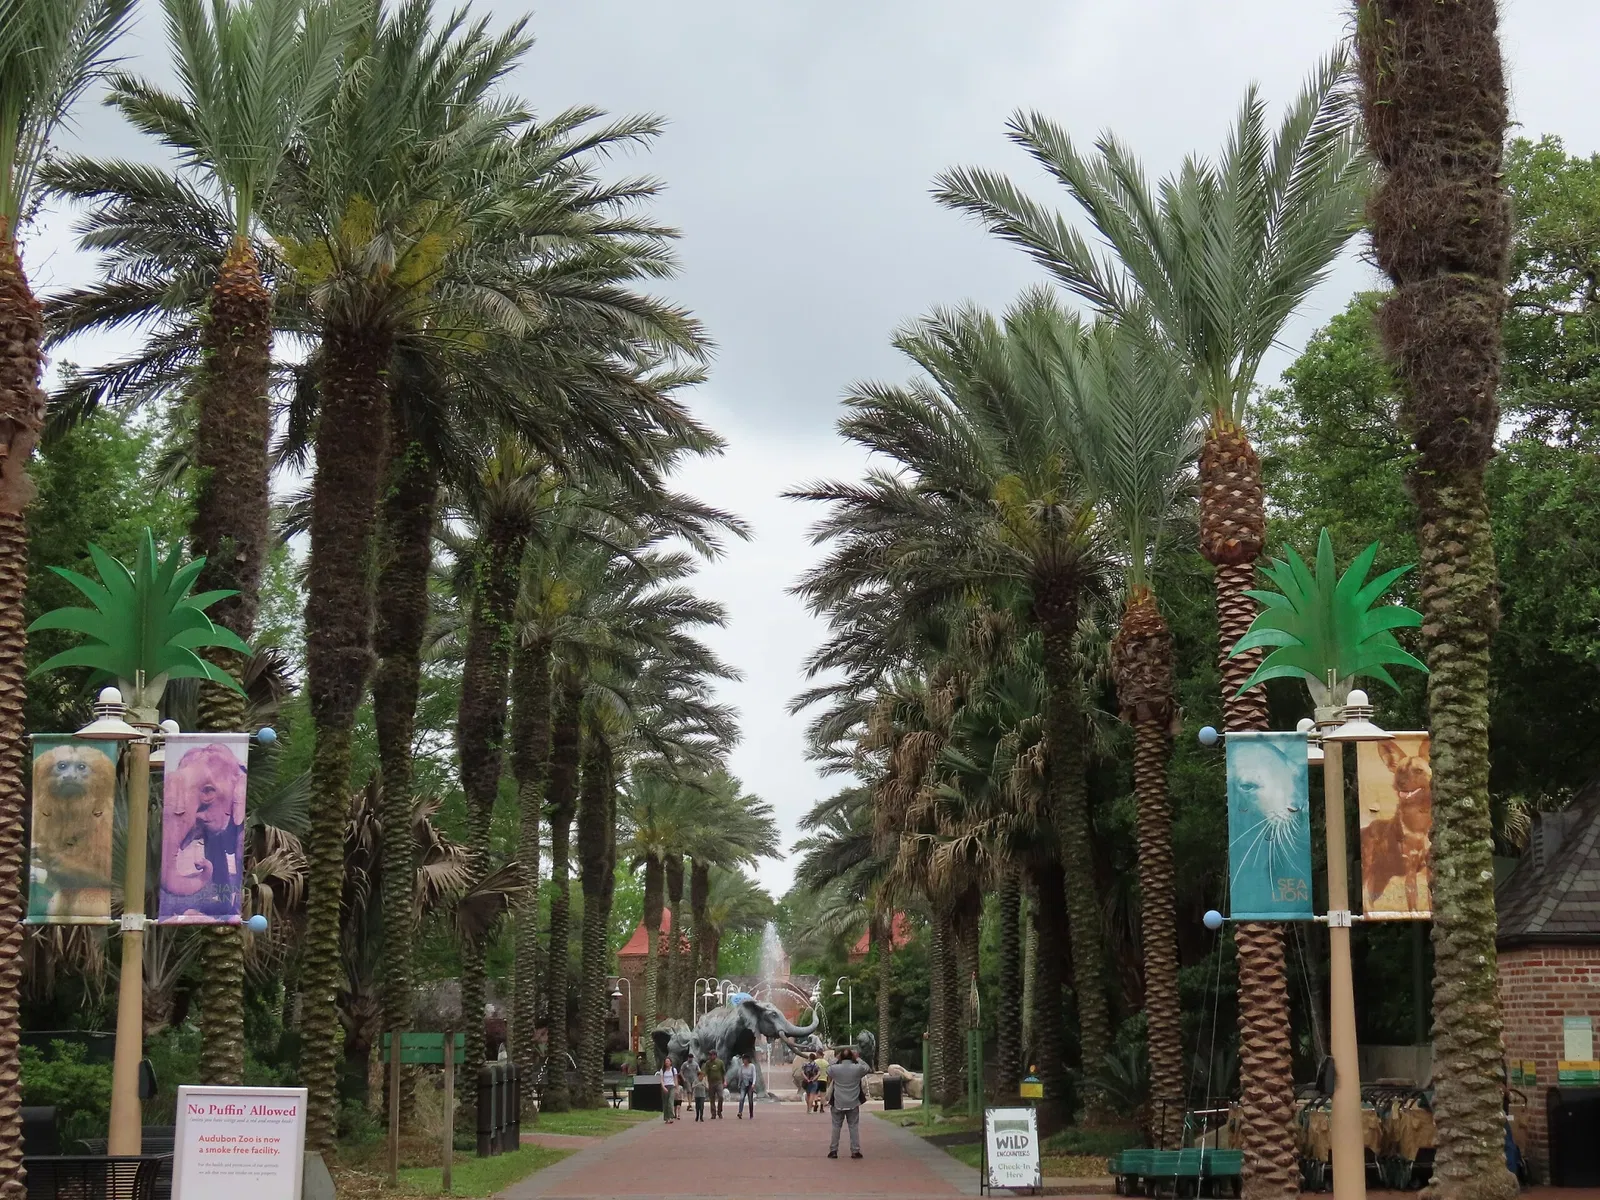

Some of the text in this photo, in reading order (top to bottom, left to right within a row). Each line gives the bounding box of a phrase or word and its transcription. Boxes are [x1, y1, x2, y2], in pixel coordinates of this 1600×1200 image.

[205, 883, 241, 893] ASIAN
[1277, 877, 1308, 890] SEA
[1272, 889, 1309, 902] LION
[187, 1104, 205, 1115] No
[250, 1105, 297, 1117] Allowed
[198, 1134, 237, 1143] Audubon
[238, 1135, 254, 1143] Zoo
[255, 1135, 262, 1143] is
[205, 1146, 232, 1154] smoke
[233, 1146, 249, 1154] free
[251, 1146, 281, 1156] facility.
[997, 1162, 1031, 1170] Check-In
[1006, 1171, 1024, 1179] Here
